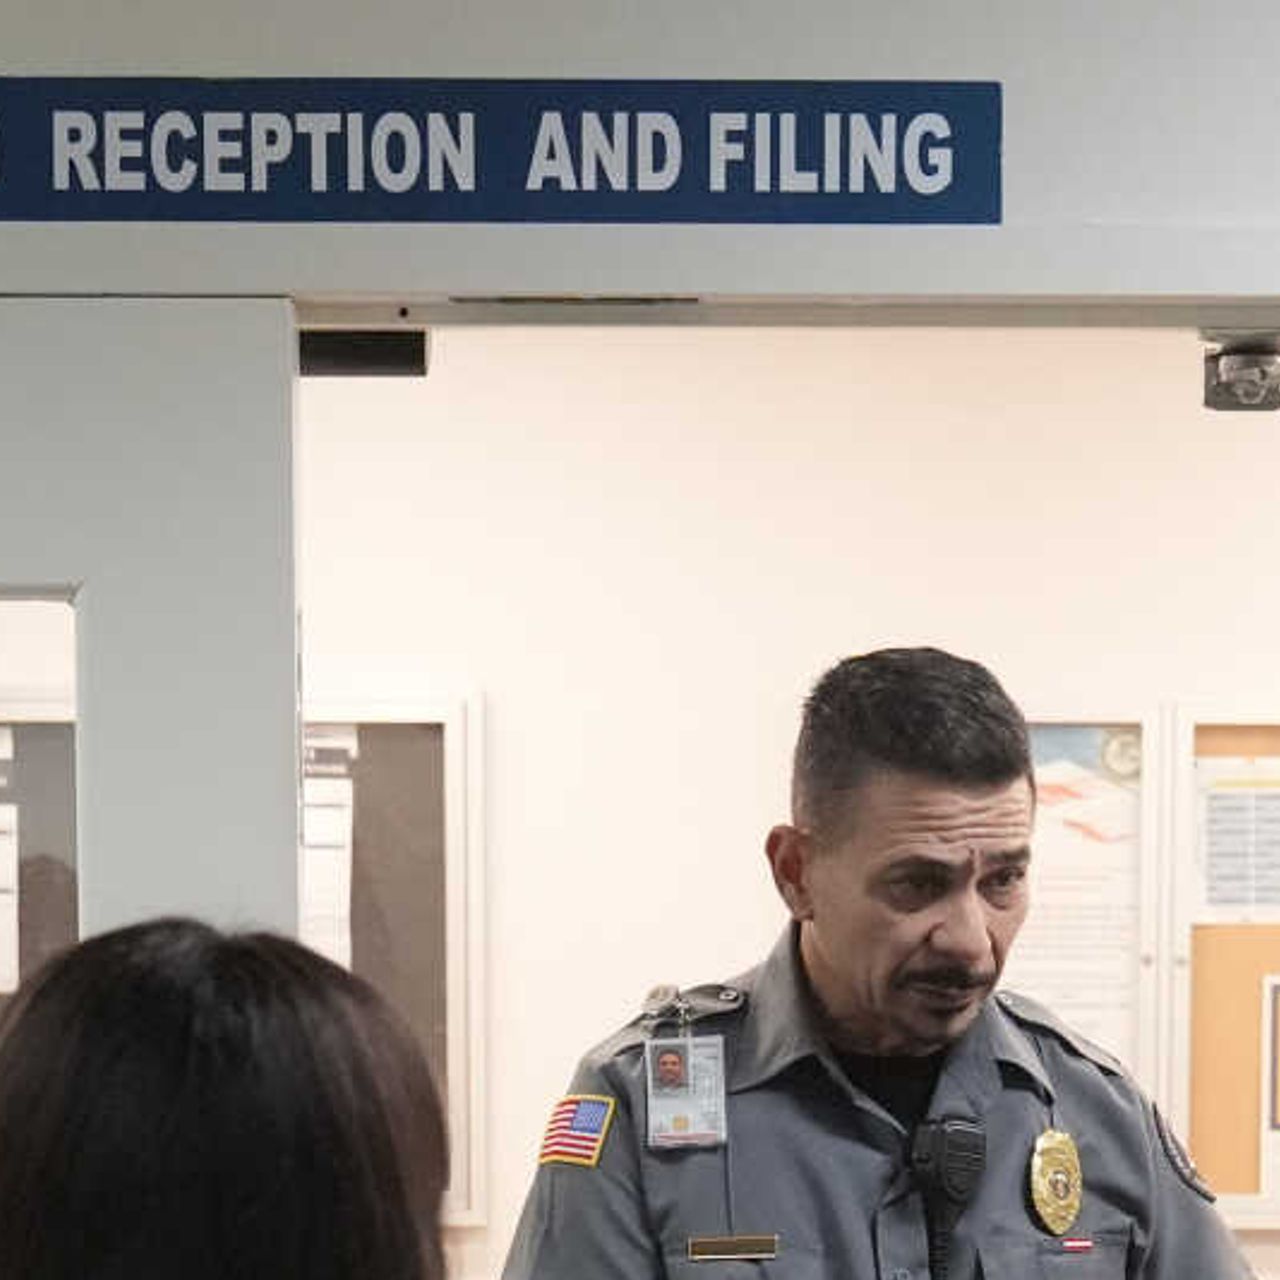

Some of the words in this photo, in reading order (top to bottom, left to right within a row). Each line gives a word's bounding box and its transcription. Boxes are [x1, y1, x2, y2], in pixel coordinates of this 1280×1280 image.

[54, 111, 475, 192] RECEPTION
[526, 111, 682, 191] AND
[709, 112, 953, 195] FILING
